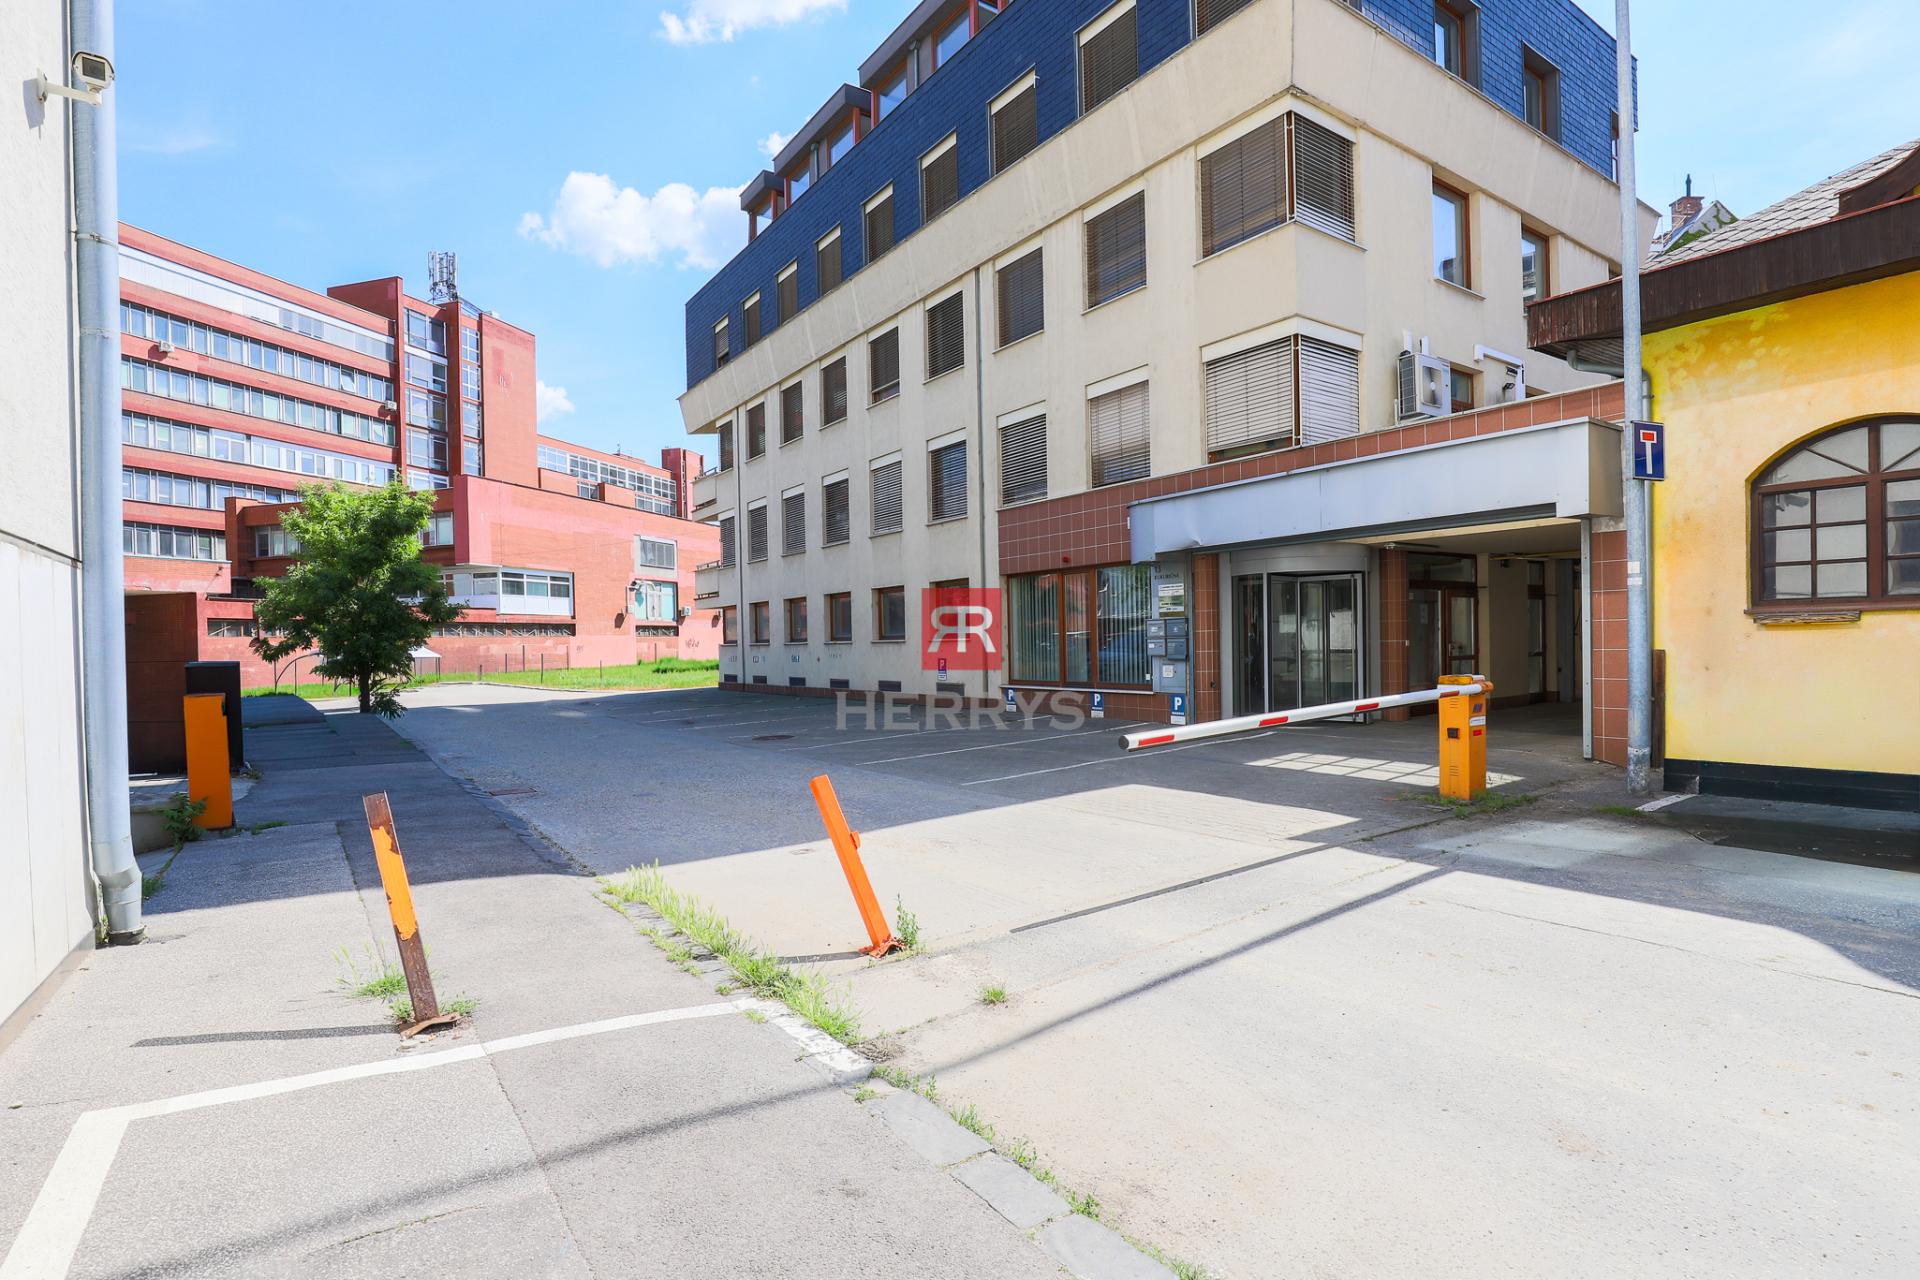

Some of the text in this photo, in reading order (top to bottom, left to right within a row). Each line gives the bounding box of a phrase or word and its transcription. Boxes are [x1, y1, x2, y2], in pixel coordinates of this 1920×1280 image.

[1008, 689, 1014, 701] P
[1094, 693, 1101, 706] P
[1174, 696, 1182, 711] P
